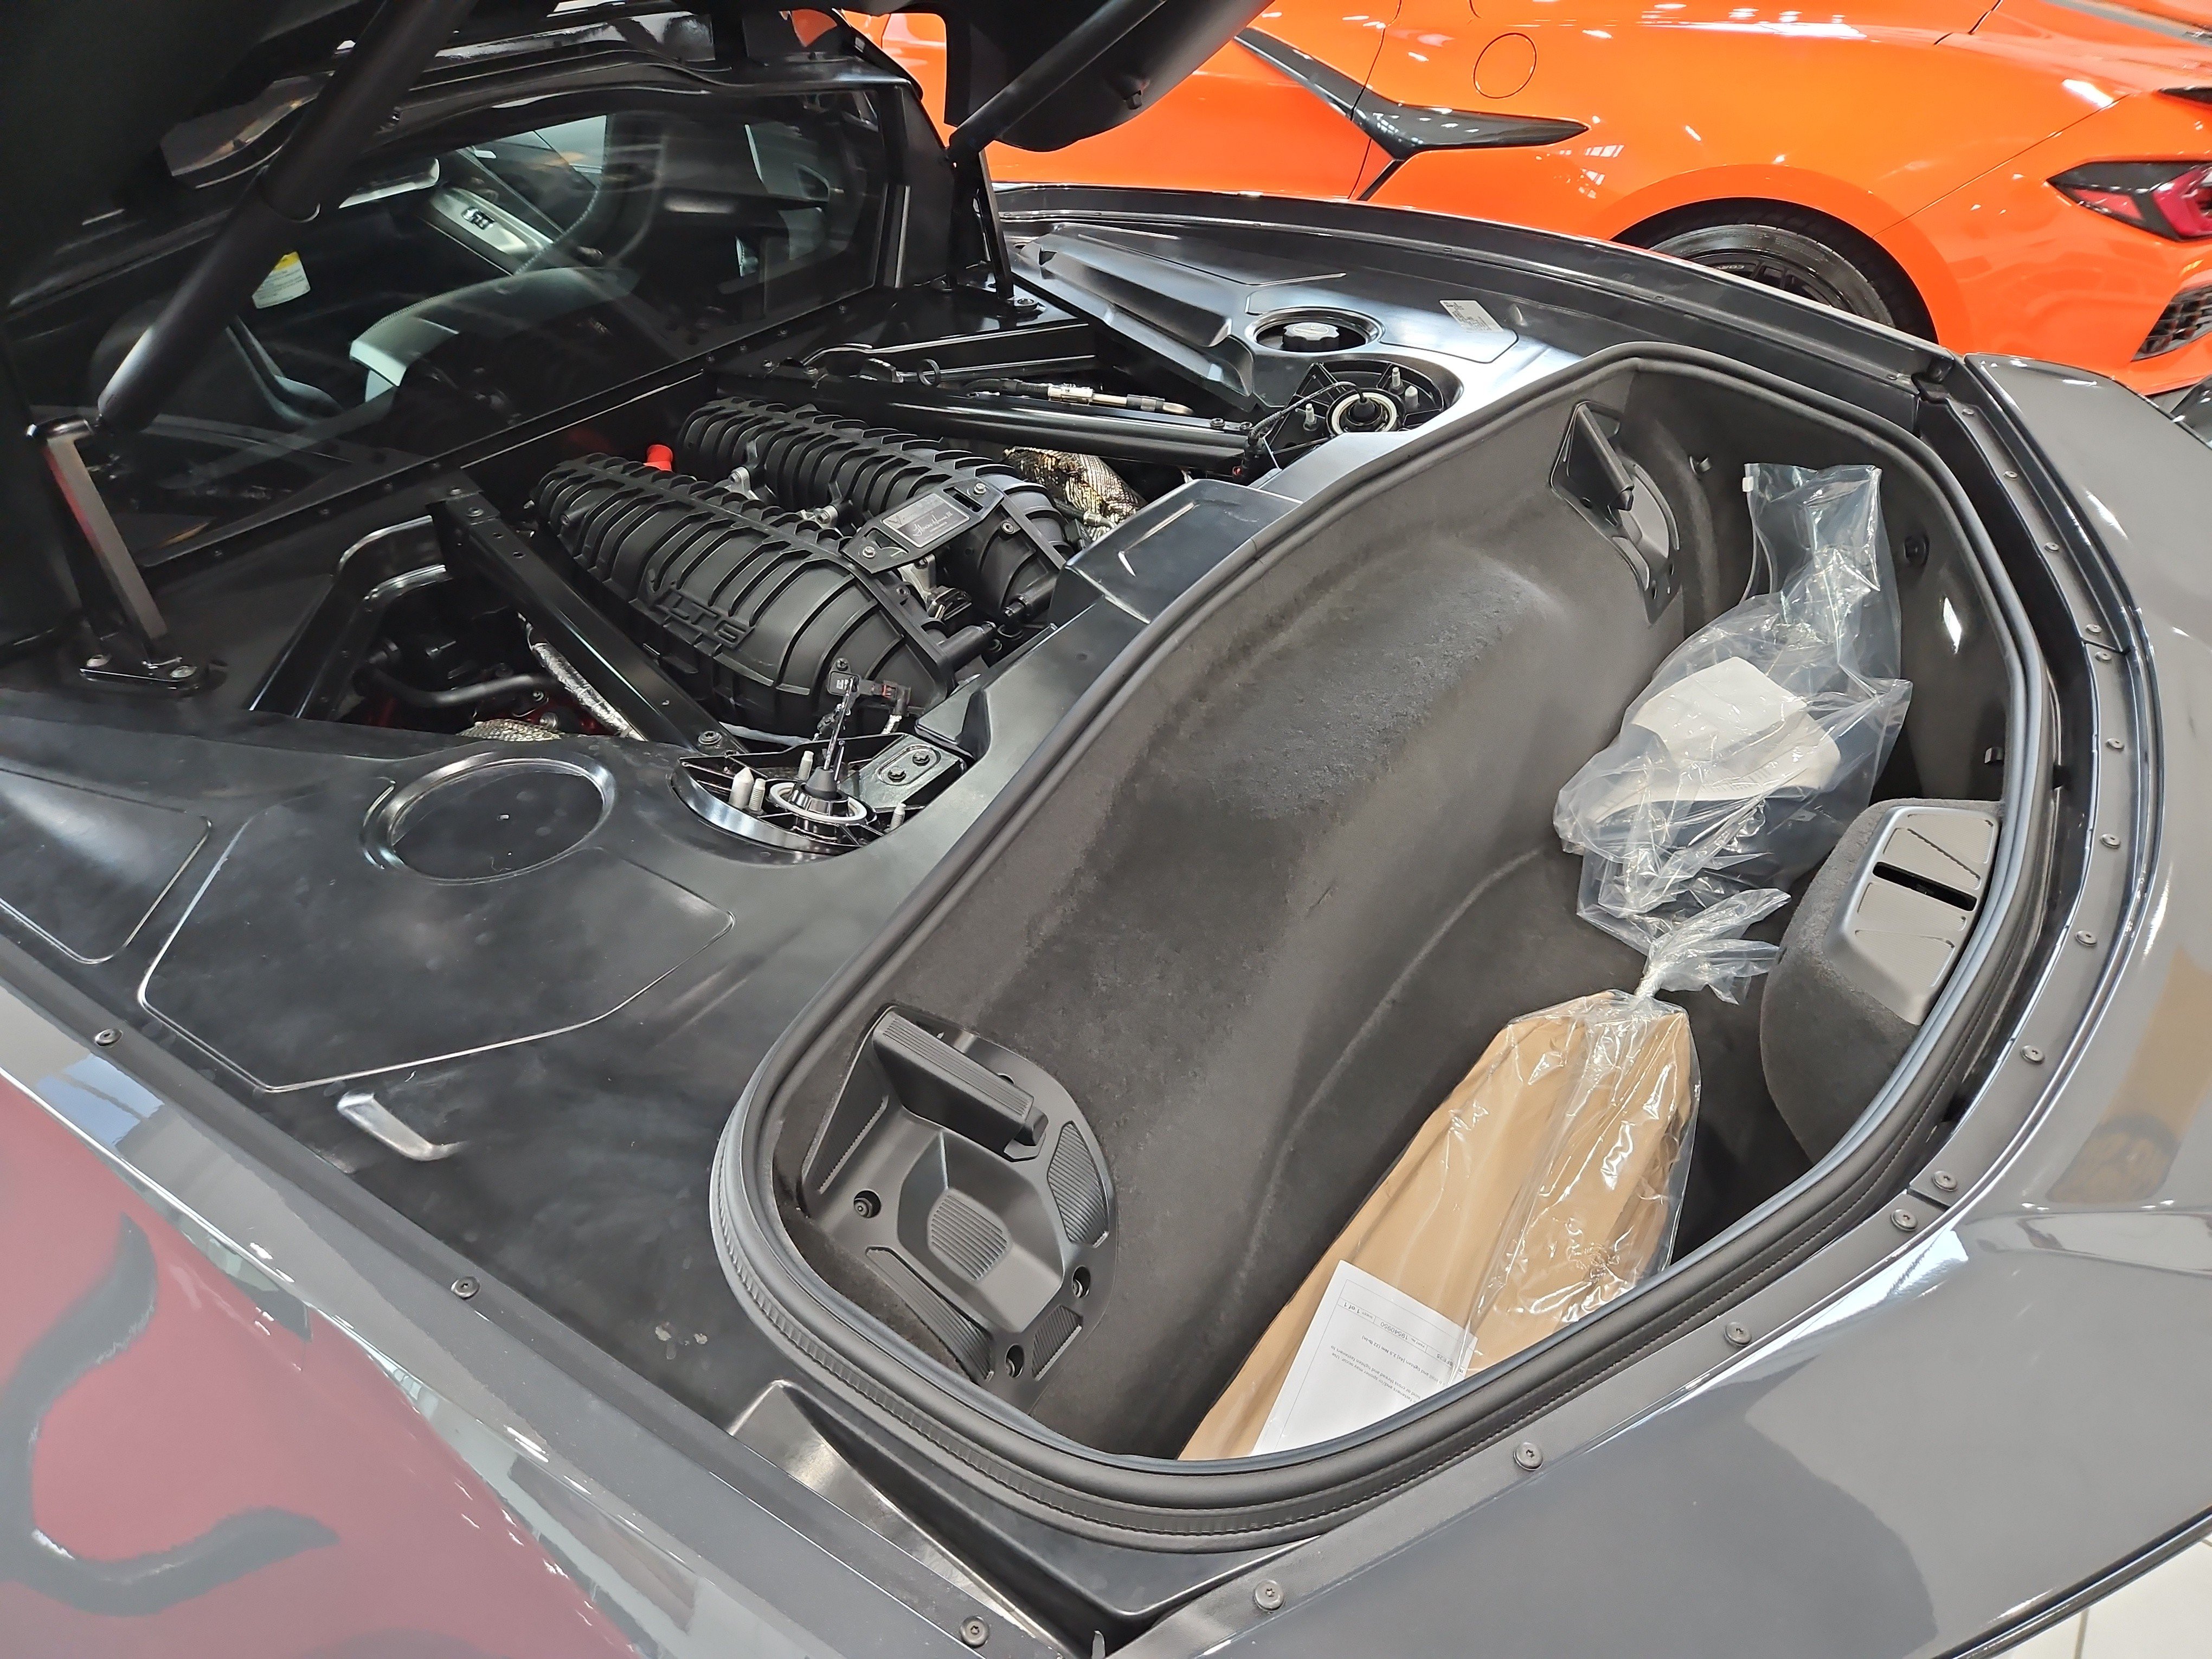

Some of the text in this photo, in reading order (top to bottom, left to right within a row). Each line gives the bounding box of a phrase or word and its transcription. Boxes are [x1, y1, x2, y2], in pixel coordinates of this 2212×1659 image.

[656, 588, 748, 647] LT6
[1380, 1321, 1408, 1340] 19540950
[1336, 1348, 1355, 1361] fasteners
[1356, 1359, 1371, 1370] tighten
[1406, 1360, 1420, 1371] tighten
[1380, 1373, 1394, 1384] thread
[1394, 1381, 1406, 1390] cross
